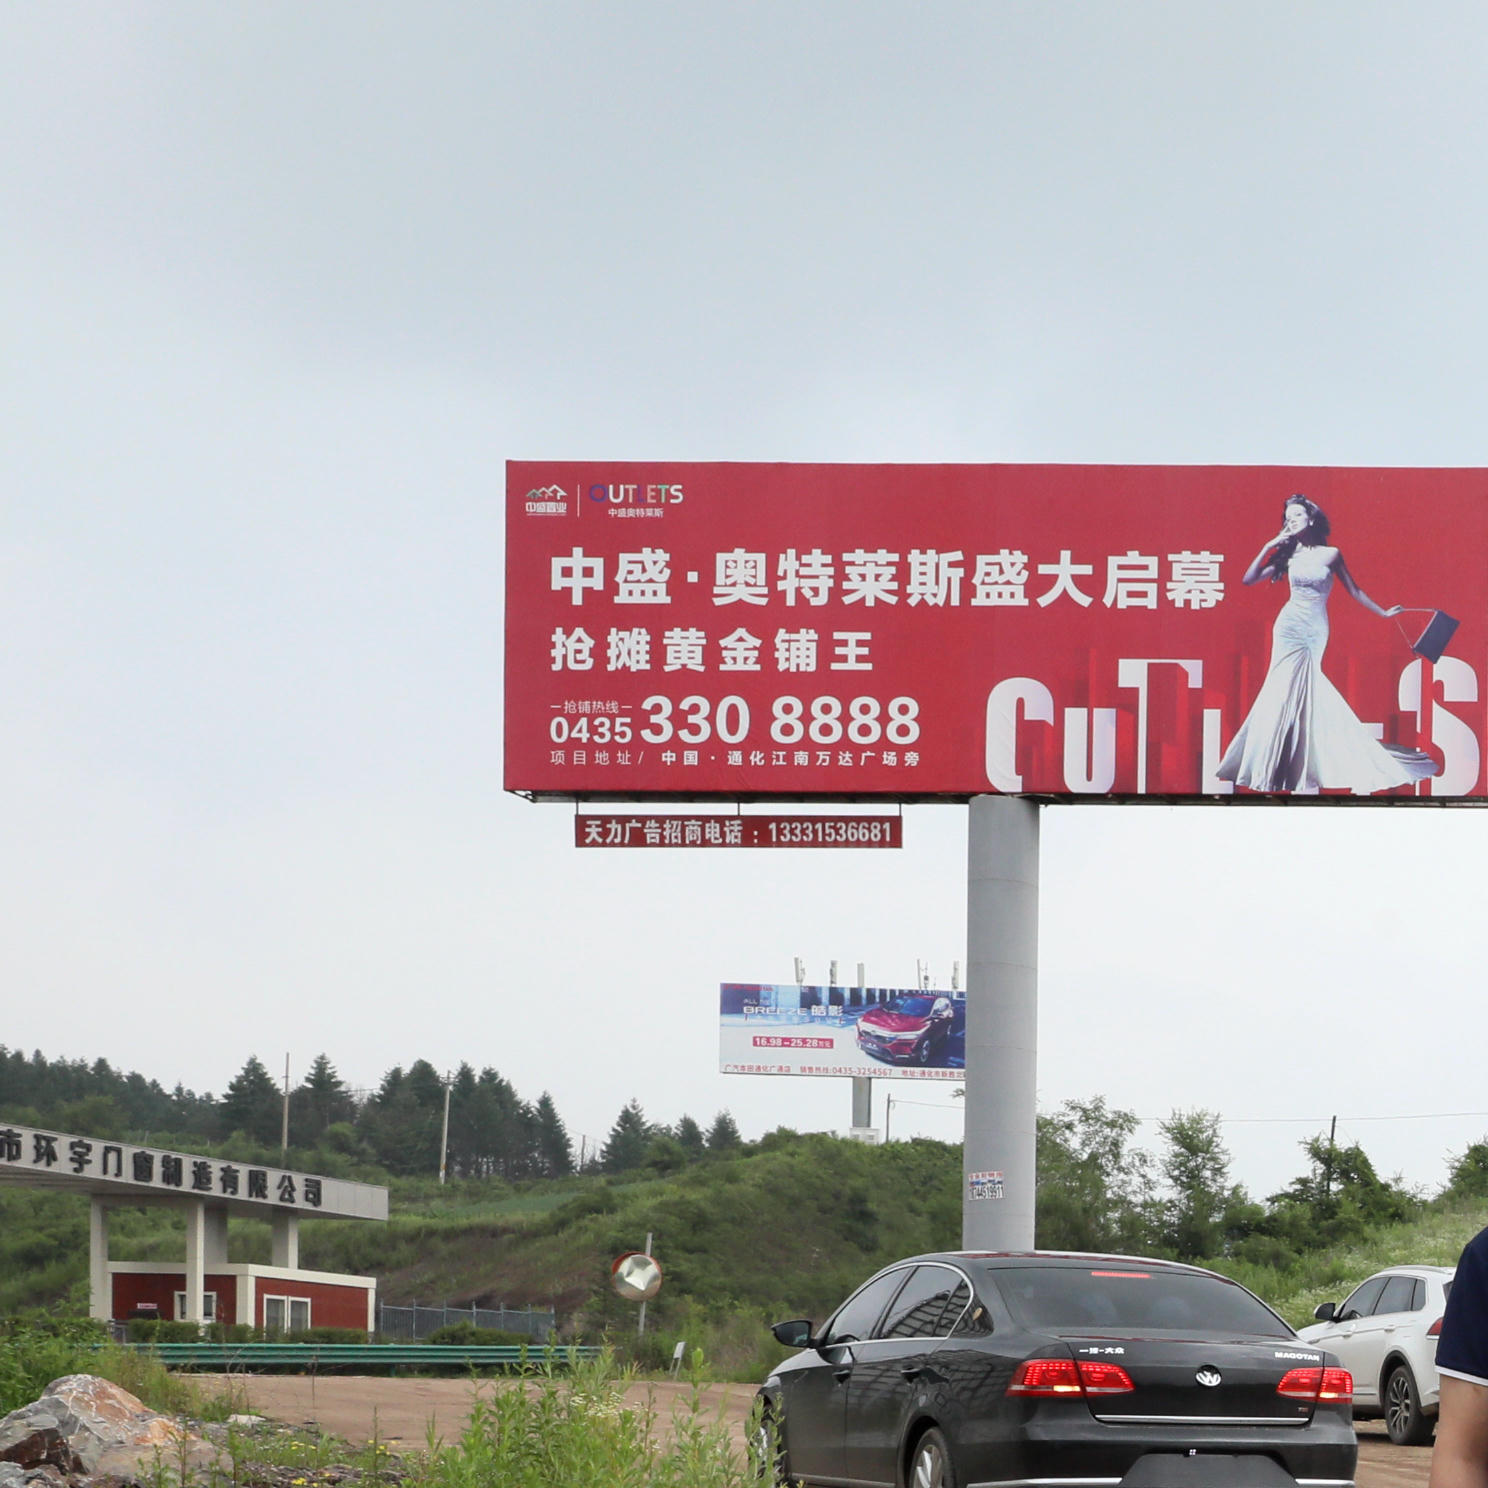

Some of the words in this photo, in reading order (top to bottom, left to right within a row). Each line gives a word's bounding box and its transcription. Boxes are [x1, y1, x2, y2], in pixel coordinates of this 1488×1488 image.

[590, 484, 683, 503] OUTLETS
[608, 508, 664, 518] 中盛奥特莱斯
[551, 627, 873, 672] 抢摊黄金铺王
[550, 716, 632, 743] 0435
[641, 695, 750, 744] 330
[770, 696, 921, 744] 8888
[1274, 1351, 1320, 1361] MAGOTAN
